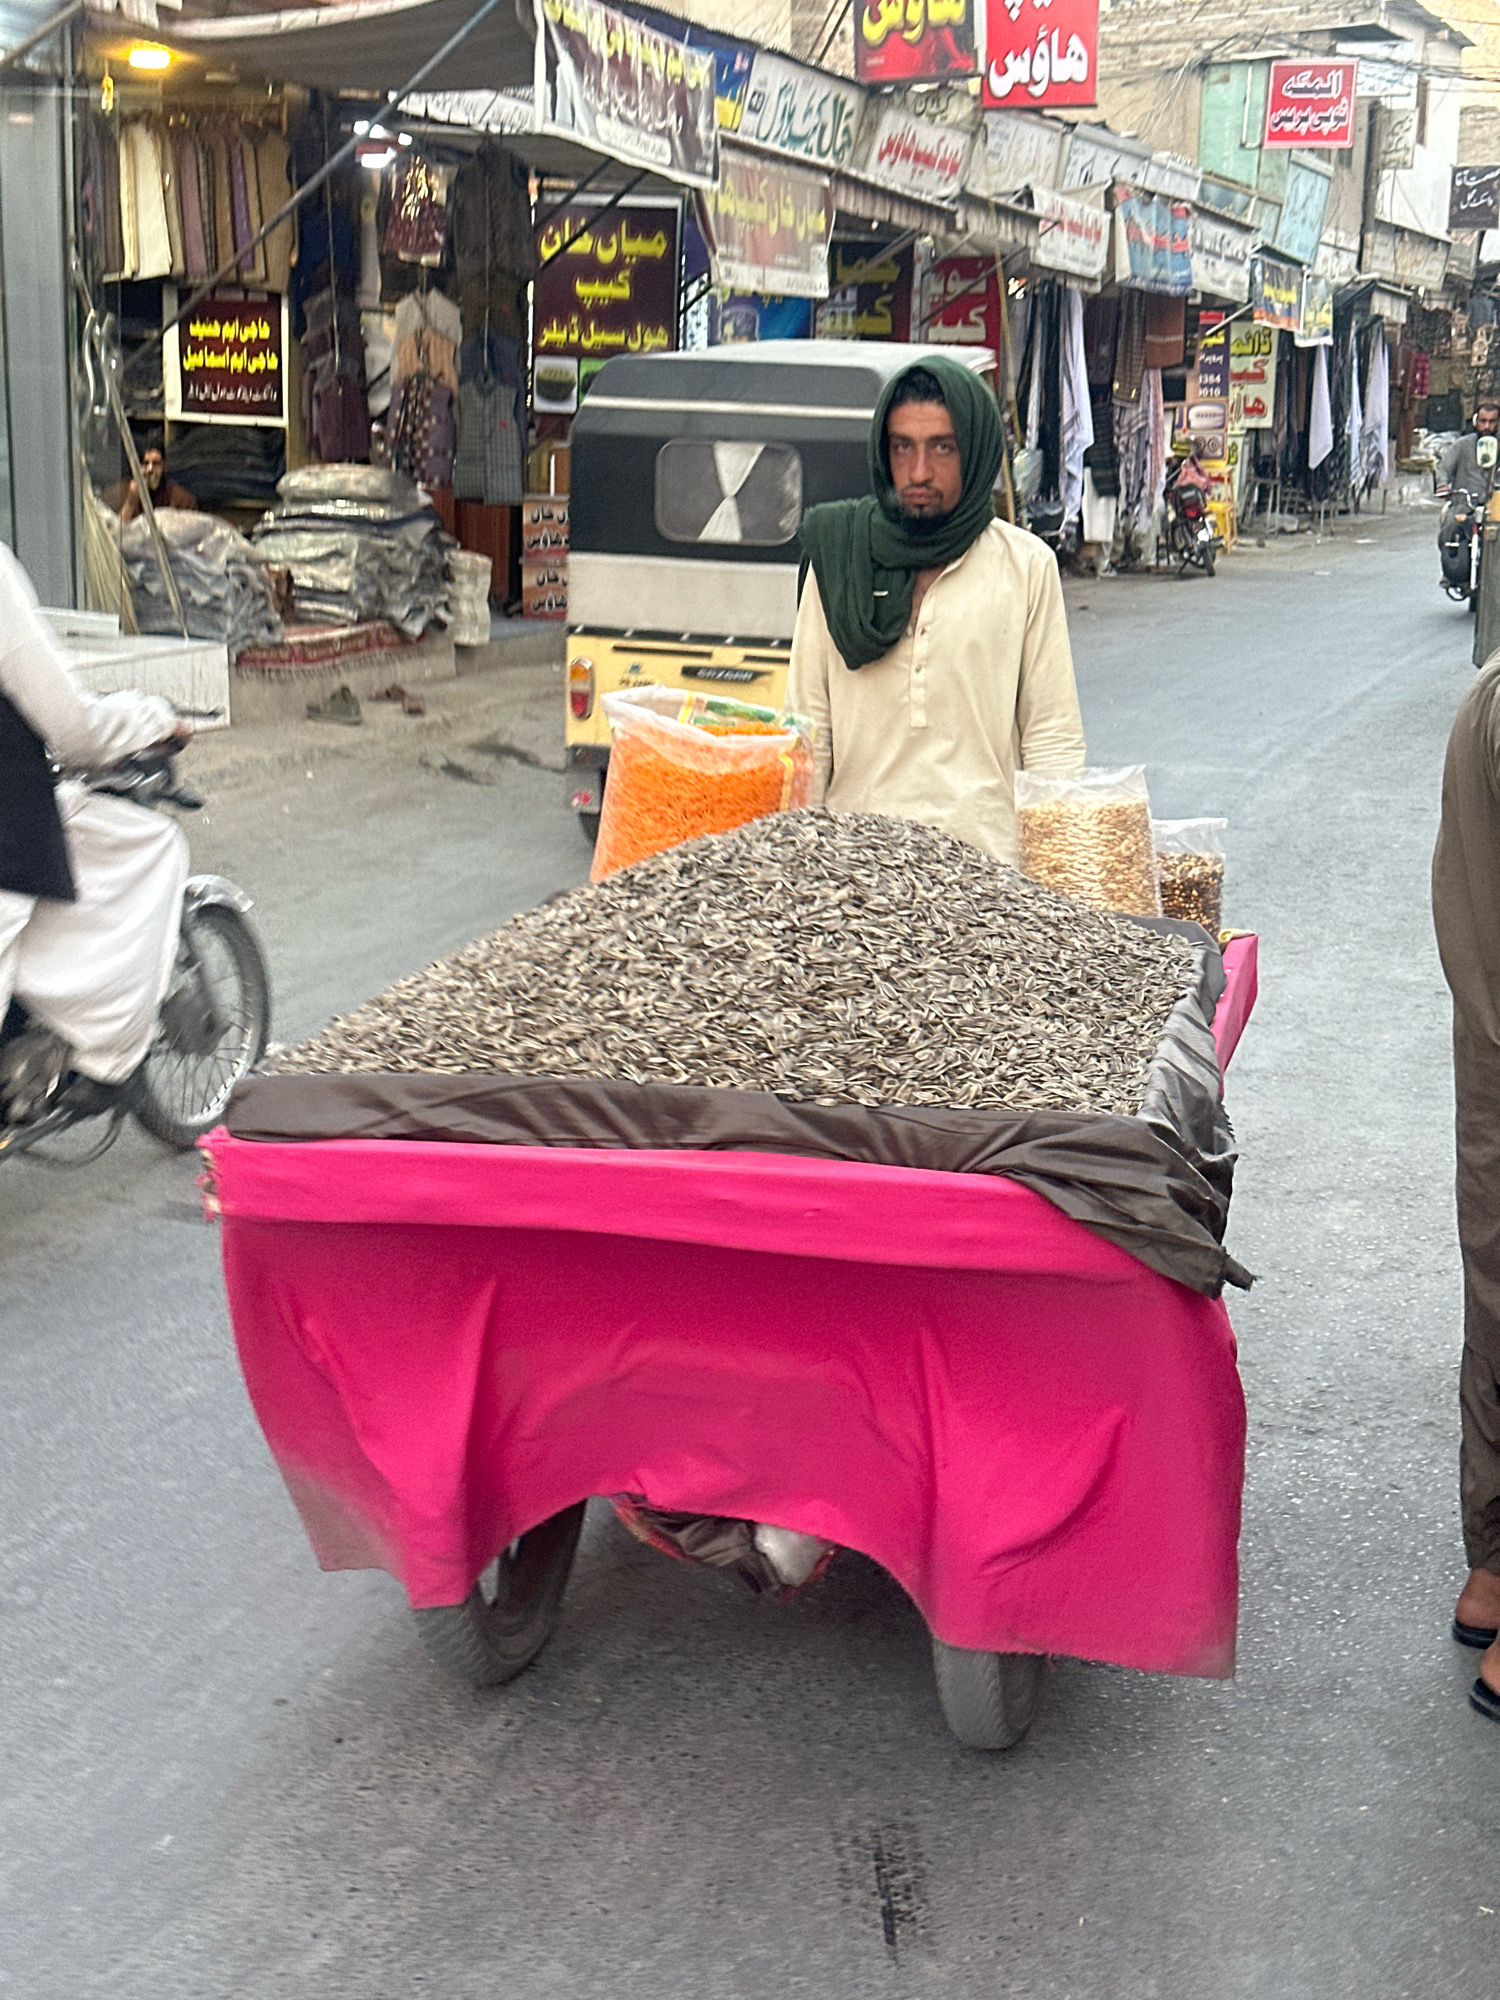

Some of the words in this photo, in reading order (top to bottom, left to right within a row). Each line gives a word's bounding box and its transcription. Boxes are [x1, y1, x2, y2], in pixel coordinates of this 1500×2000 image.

[989, 24, 1088, 98] ہاؤس
[1281, 69, 1343, 99] المکہ
[540, 216, 594, 264] خان
[596, 219, 668, 265] میاں
[575, 269, 631, 309] کیپ
[222, 315, 239, 344] ایم
[239, 316, 270, 343] حاجی
[538, 313, 579, 349] ڈیلر
[581, 319, 625, 350] سیل
[627, 321, 669, 353] ہول
[183, 344, 230, 371] اسماعیل
[230, 347, 247, 374] ایم
[247, 347, 278, 374] حاجی
